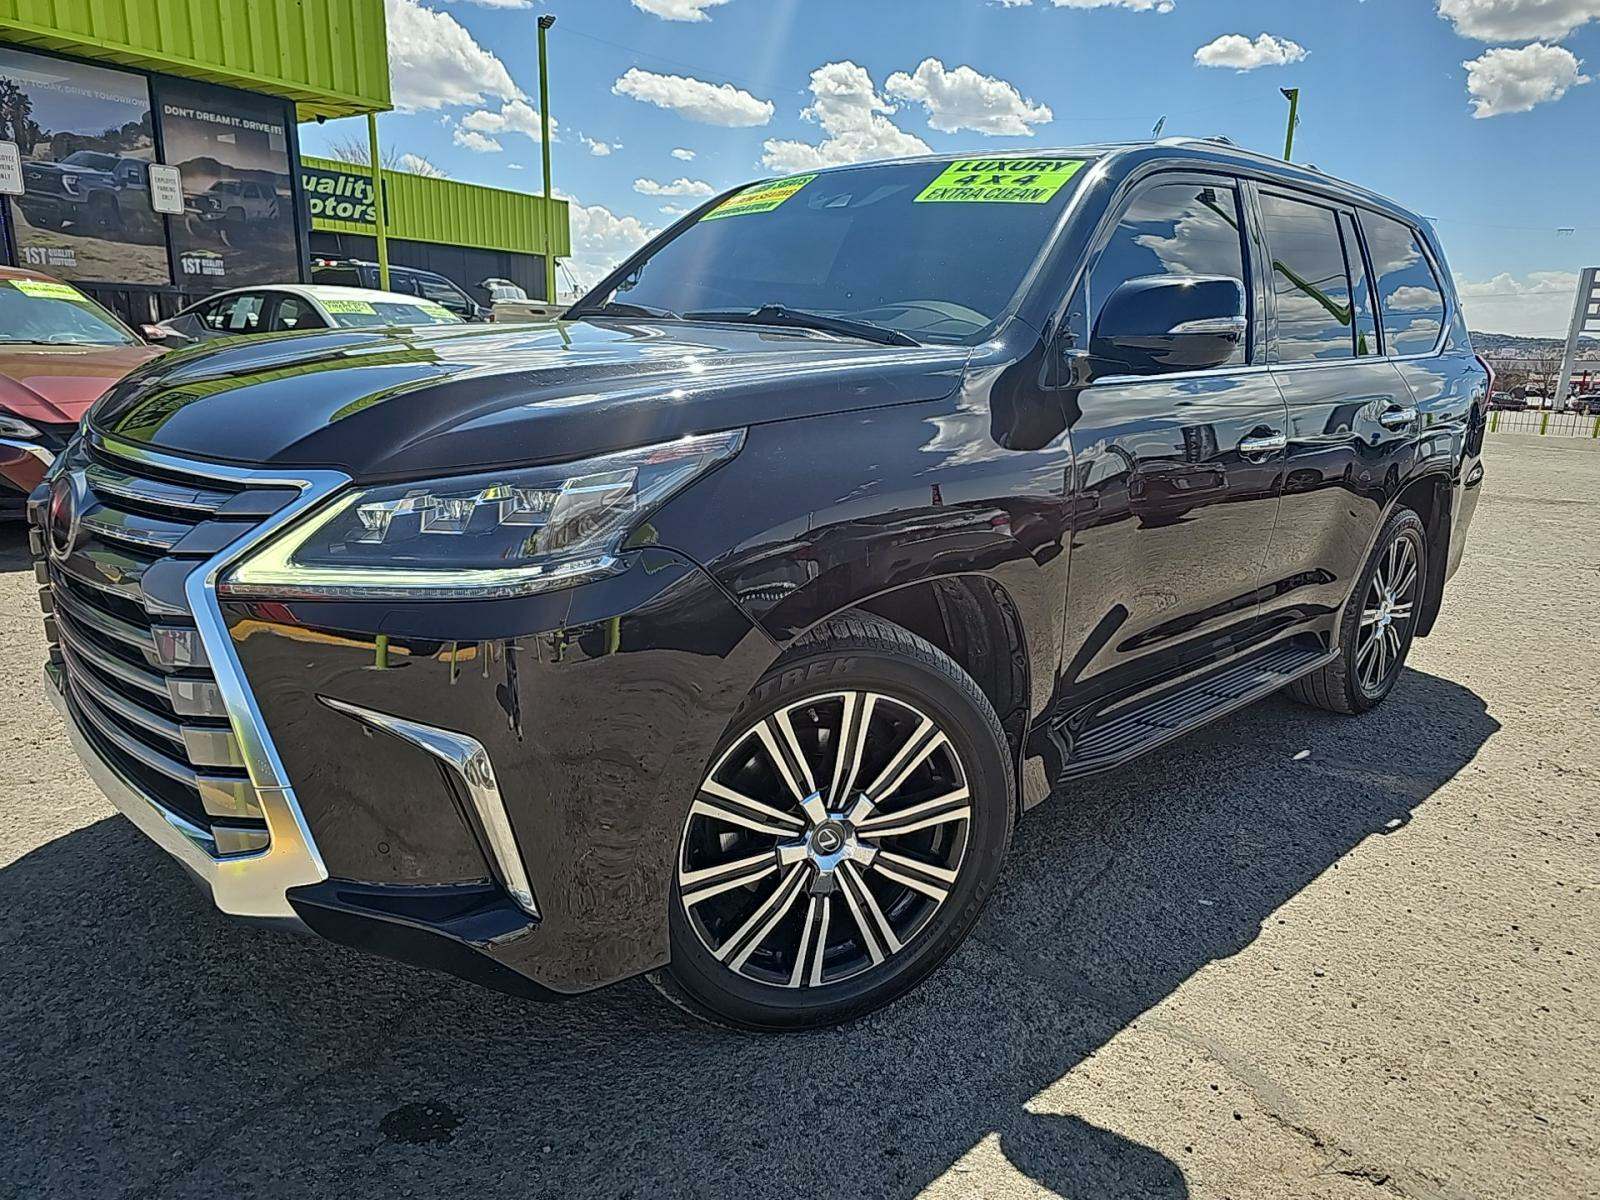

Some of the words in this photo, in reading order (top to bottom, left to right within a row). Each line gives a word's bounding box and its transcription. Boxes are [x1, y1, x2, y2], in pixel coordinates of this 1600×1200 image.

[164, 104, 195, 118] DON'T
[196, 111, 231, 126] DREAM
[242, 119, 270, 133] DRIVE
[954, 160, 1077, 173] LUXURY
[302, 175, 374, 204] uality
[924, 187, 983, 200] EXTRA
[983, 188, 1047, 200] CLEAN
[310, 197, 376, 221] otors
[23, 246, 47, 265] 1ST
[181, 257, 201, 274] 1ST
